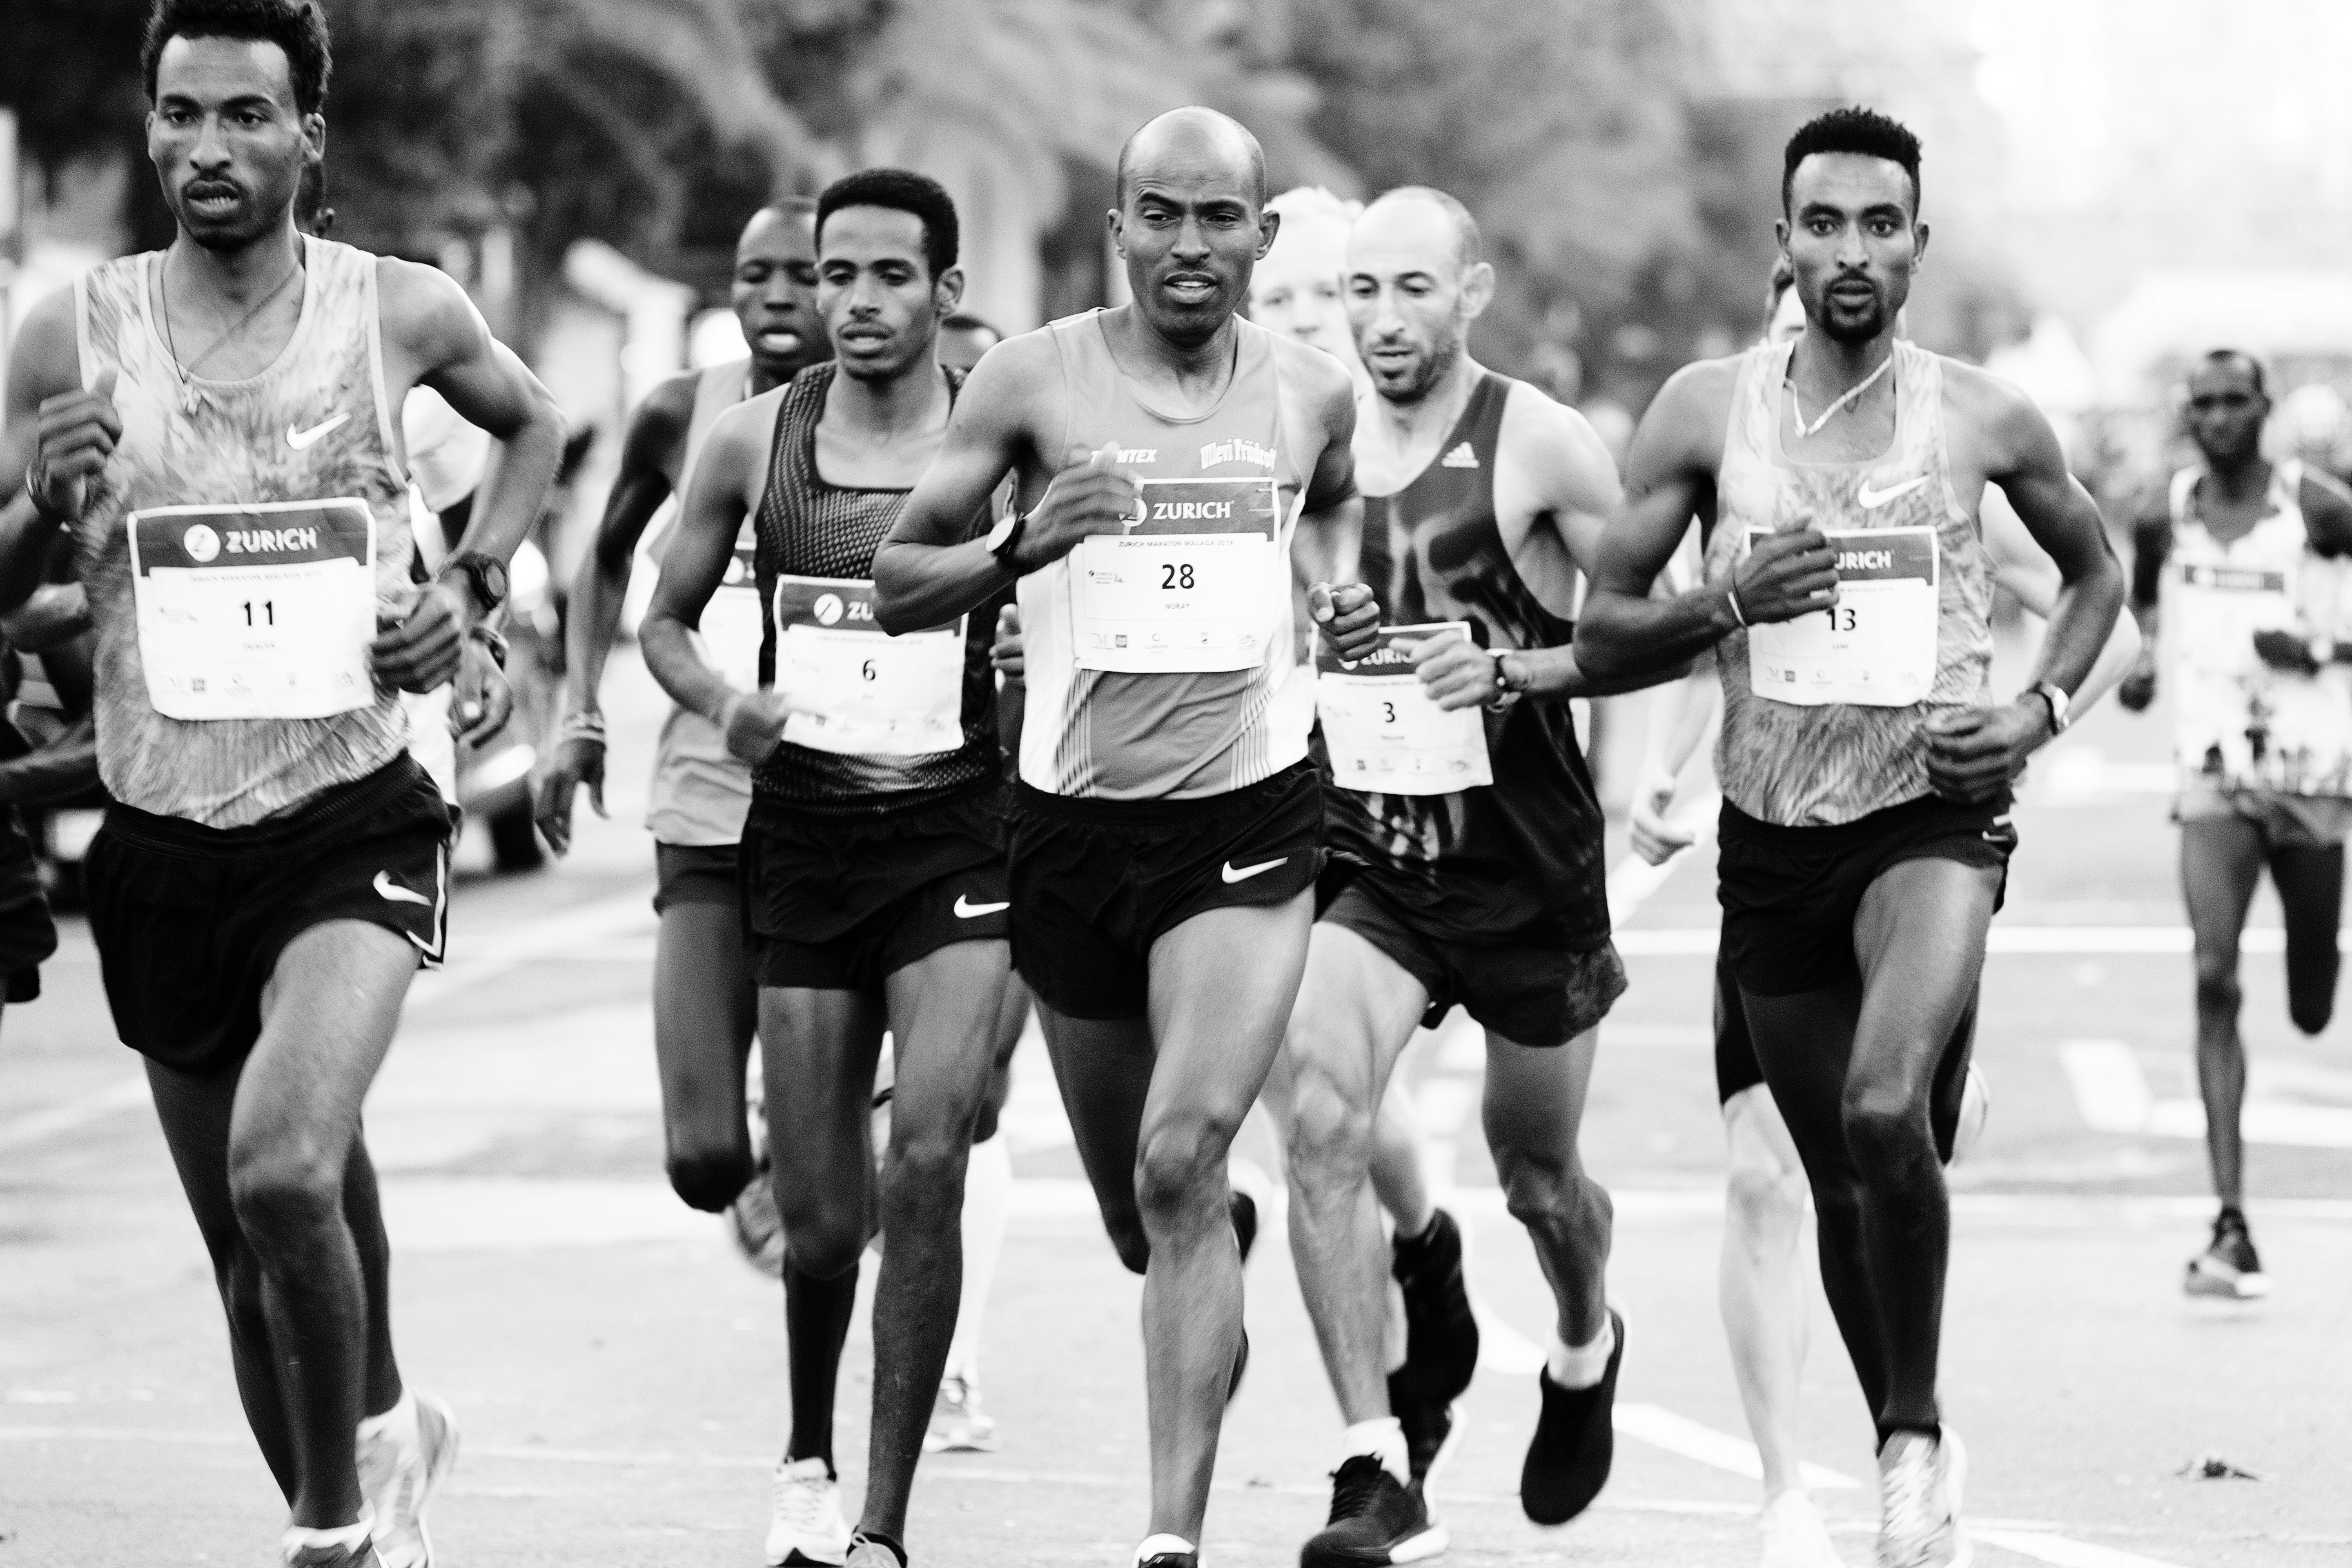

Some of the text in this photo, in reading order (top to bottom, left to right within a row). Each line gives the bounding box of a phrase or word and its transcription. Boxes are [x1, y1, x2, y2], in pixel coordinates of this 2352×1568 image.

[1091, 449, 1158, 465] TMTEX
[1152, 501, 1231, 520] ZURICH
[225, 527, 318, 553] ZURICH
[1834, 550, 1892, 570] URICH
[1162, 564, 1195, 589] 28
[241, 601, 274, 626] 11
[1826, 608, 1856, 631] 13
[863, 659, 876, 681] 6
[1383, 702, 1395, 723] 3
